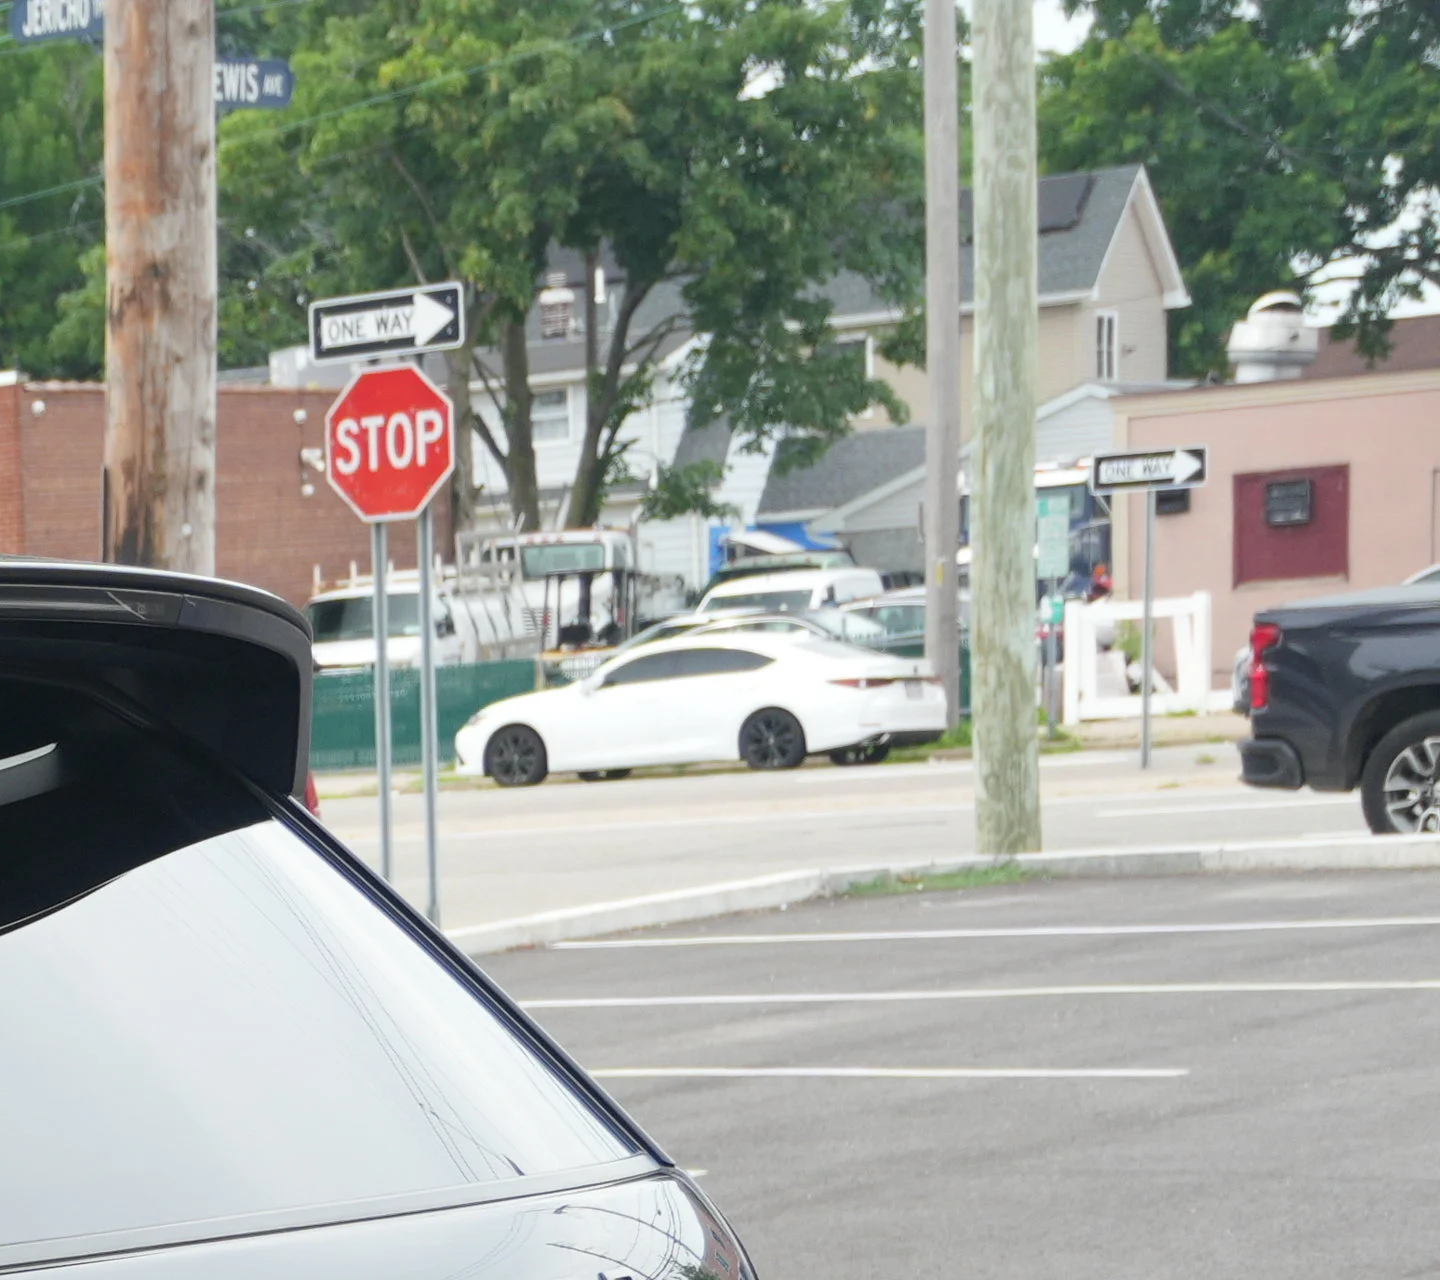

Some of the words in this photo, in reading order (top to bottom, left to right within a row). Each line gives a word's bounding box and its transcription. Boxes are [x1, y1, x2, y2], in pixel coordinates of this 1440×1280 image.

[22, 0, 90, 37] JERICHO
[214, 62, 259, 103] EWIS
[263, 73, 284, 97] AVE
[328, 317, 366, 342] ONE
[374, 309, 414, 335] WAY
[335, 408, 445, 475] STOP
[1104, 462, 1132, 480] ONE
[1142, 455, 1173, 475] WAY
